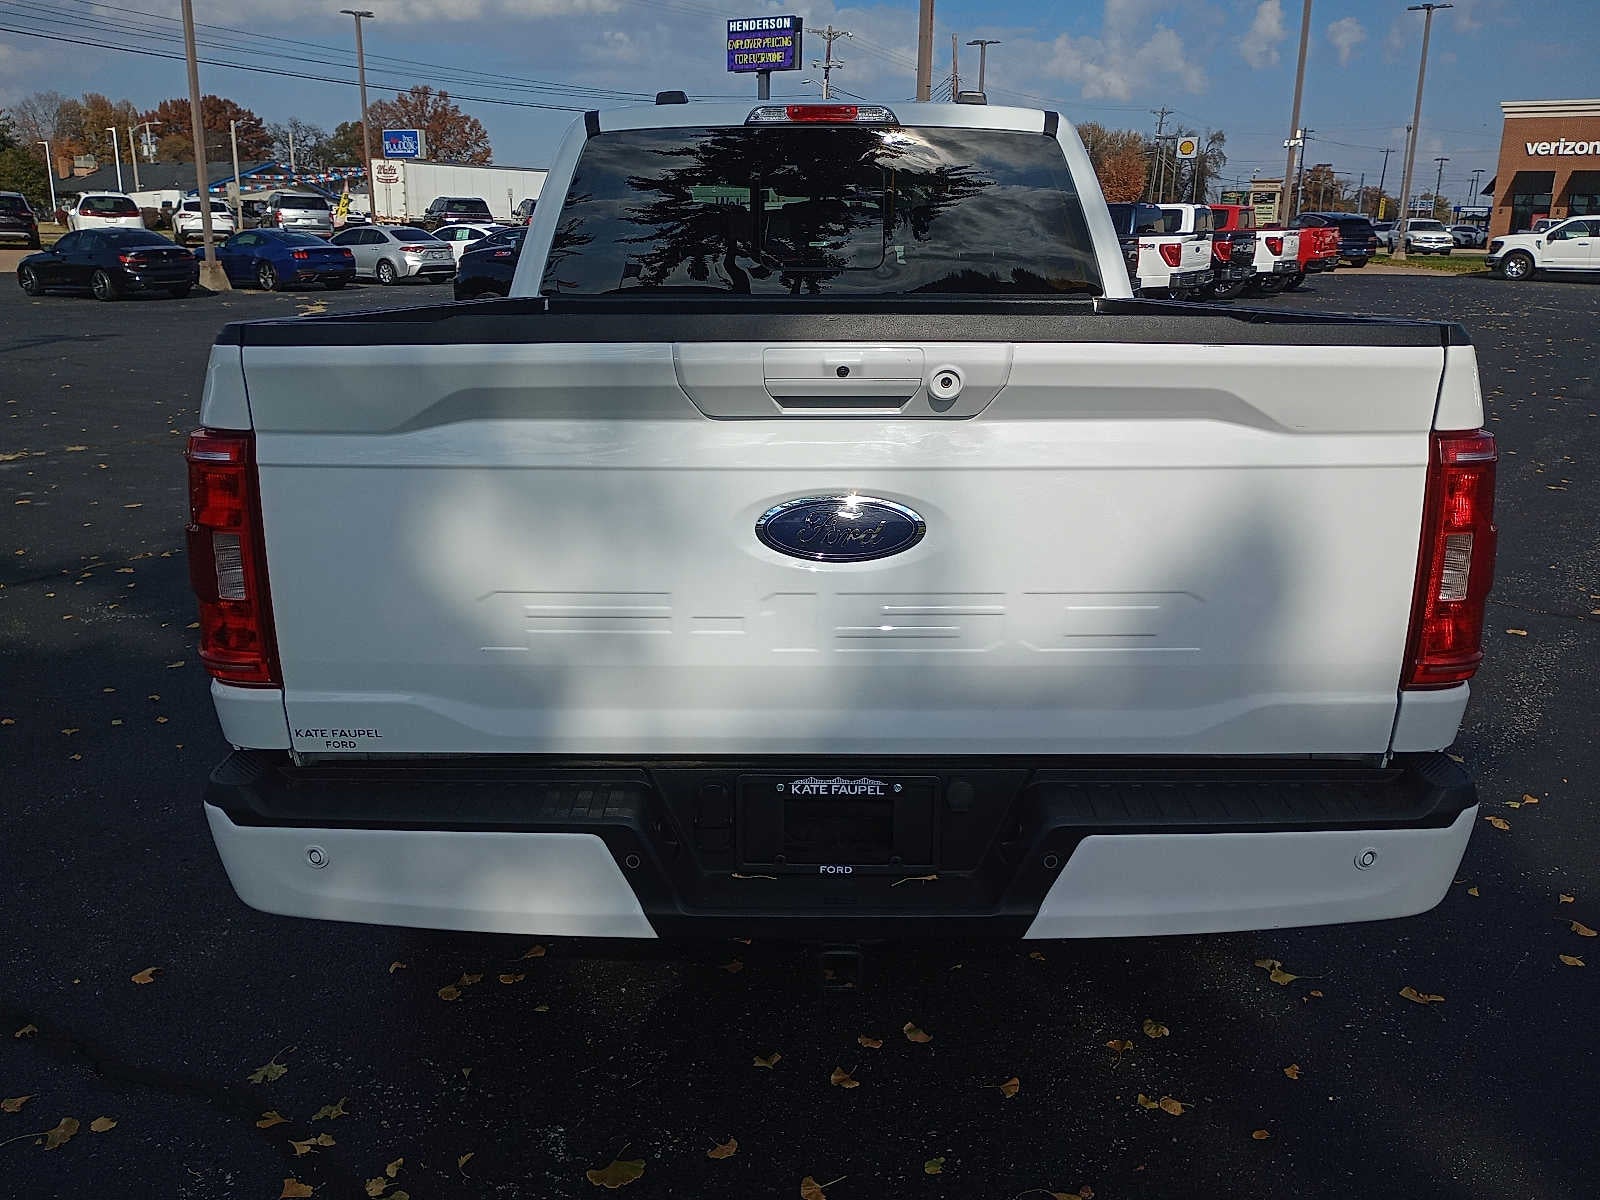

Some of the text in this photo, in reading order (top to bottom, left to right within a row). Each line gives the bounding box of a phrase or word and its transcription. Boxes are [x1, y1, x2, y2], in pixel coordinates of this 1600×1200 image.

[729, 17, 790, 31] HENDERSON
[735, 53, 748, 64] FOR
[1526, 137, 1600, 155] verizon
[799, 510, 887, 547] Ford
[295, 729, 383, 738] KATE FAUPEL
[325, 740, 356, 748] FORD
[791, 784, 885, 795] KATE FAUPEL
[819, 865, 853, 874] FORD
